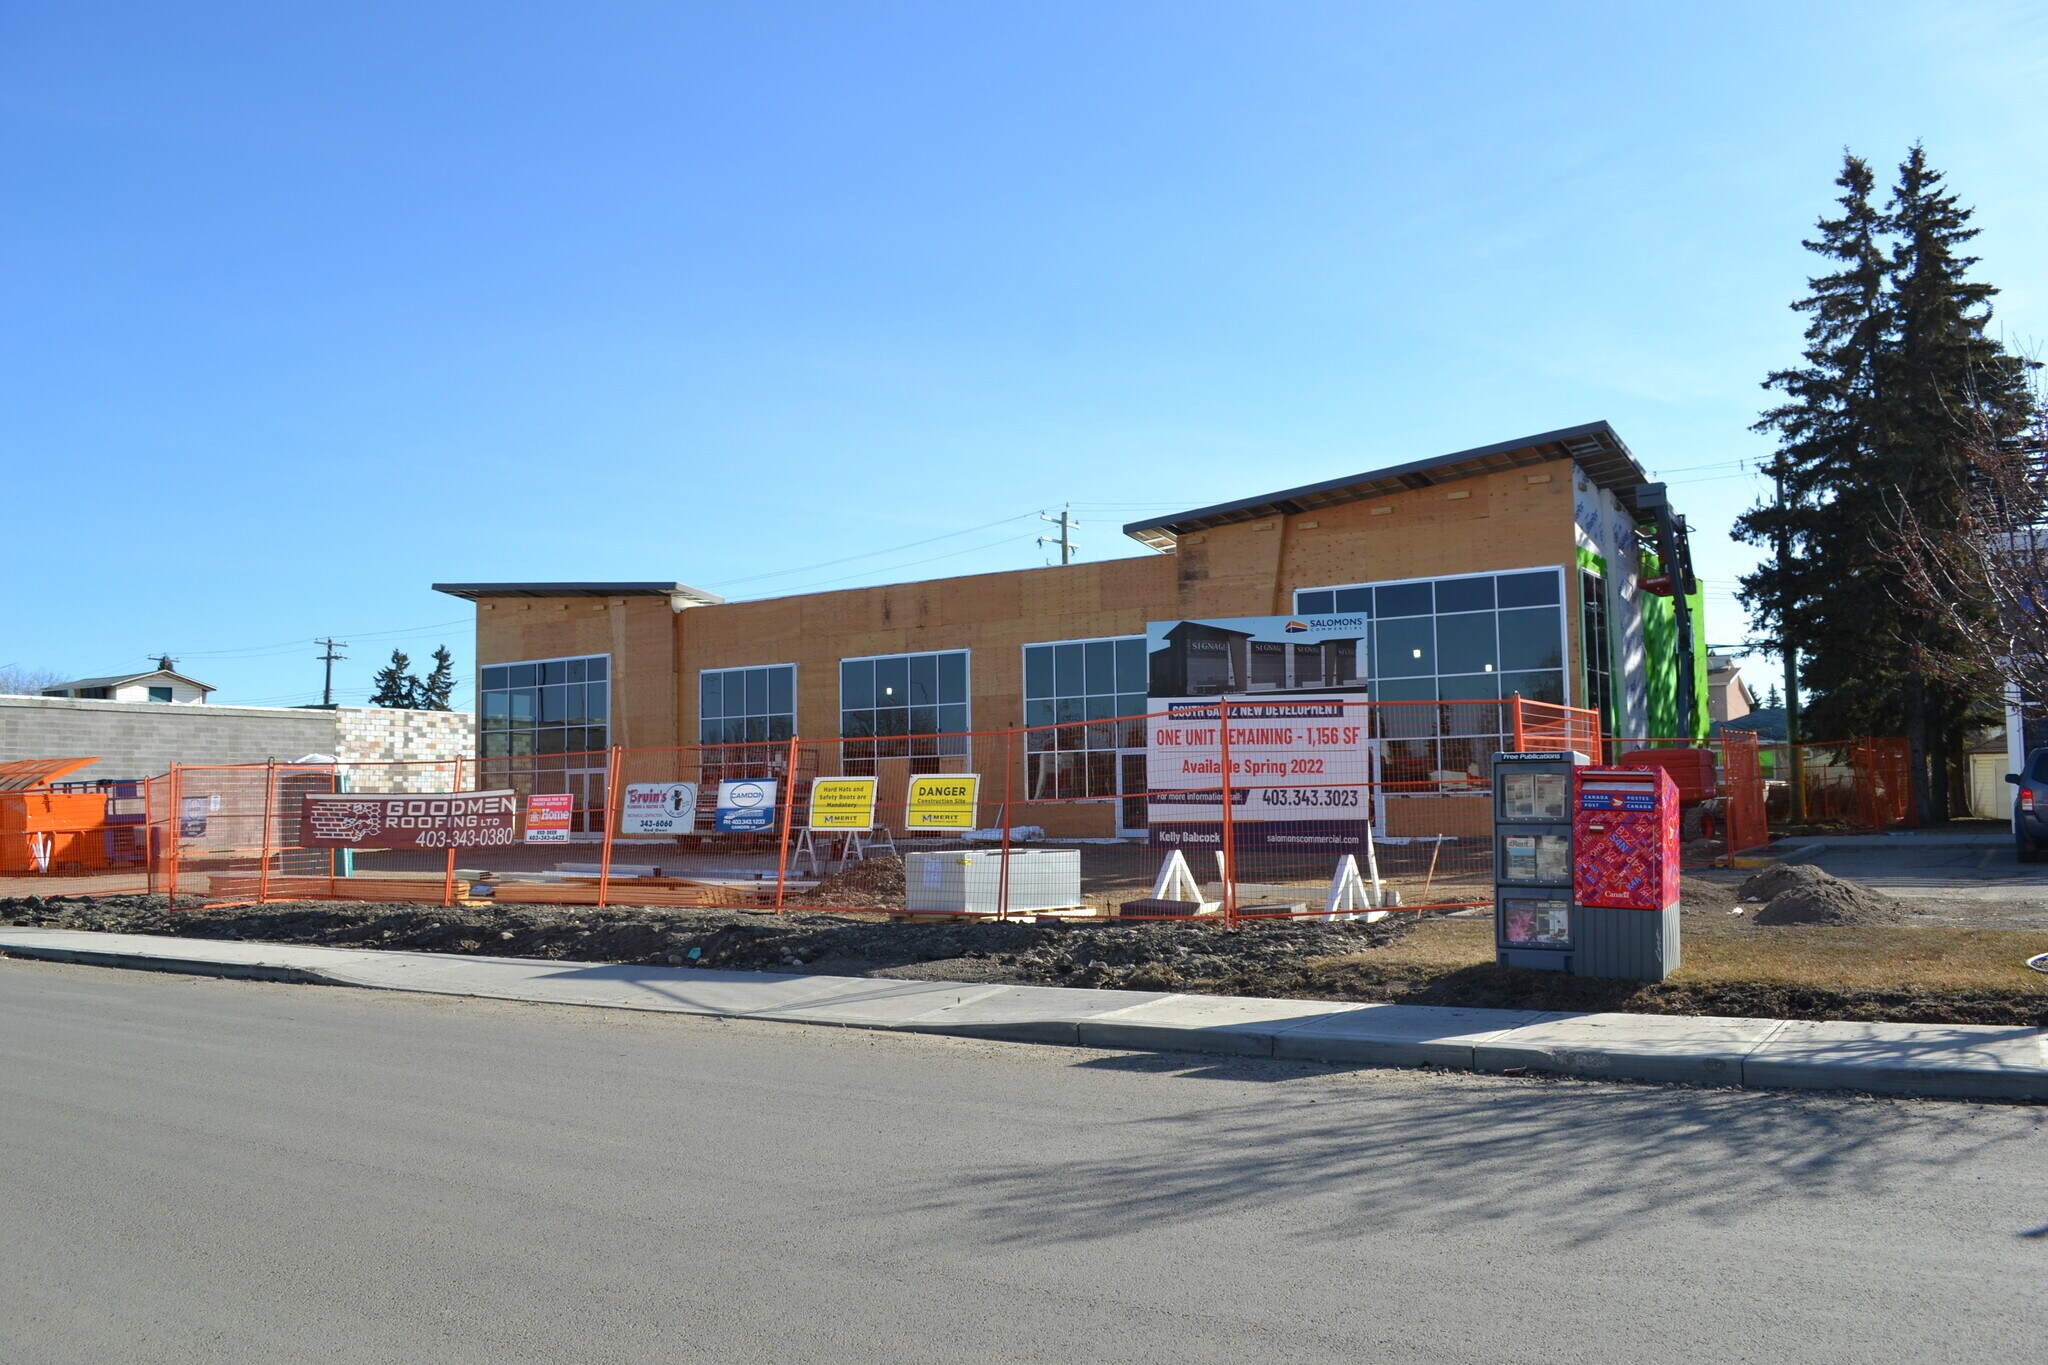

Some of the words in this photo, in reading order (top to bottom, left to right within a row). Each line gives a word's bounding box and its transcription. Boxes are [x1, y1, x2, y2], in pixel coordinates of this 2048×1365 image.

[1310, 618, 1363, 627] SALOMONS
[1192, 642, 1227, 651] SIGNAGE
[1172, 705, 1204, 717] SOUTH
[1206, 704, 1238, 717] GATZ
[1240, 704, 1263, 716] NEW
[1265, 704, 1338, 716] DEVELOPMENT
[1156, 729, 1182, 746] ONE
[1185, 729, 1216, 746] UNIT
[1220, 728, 1292, 745] EMAINING
[1307, 728, 1339, 747] 1,156
[1343, 727, 1360, 744] SF
[1244, 759, 1287, 777] Spring
[1290, 759, 1324, 774] 2022
[628, 788, 667, 803] Bruin's
[919, 787, 966, 796] DANGER
[1187, 792, 1224, 800] information
[1262, 790, 1358, 807] 403.343.3023
[386, 796, 516, 816] GOODMEN
[542, 808, 569, 820] Home
[386, 816, 478, 828] ROOFING
[415, 827, 513, 847] 403-343-0380
[1160, 832, 1180, 844] Kelly
[1182, 832, 1220, 842] Babcock
[1267, 834, 1359, 844] salomonscommercial.com
[1616, 826, 1636, 846] B2Z
[1610, 834, 1629, 852] S4N
